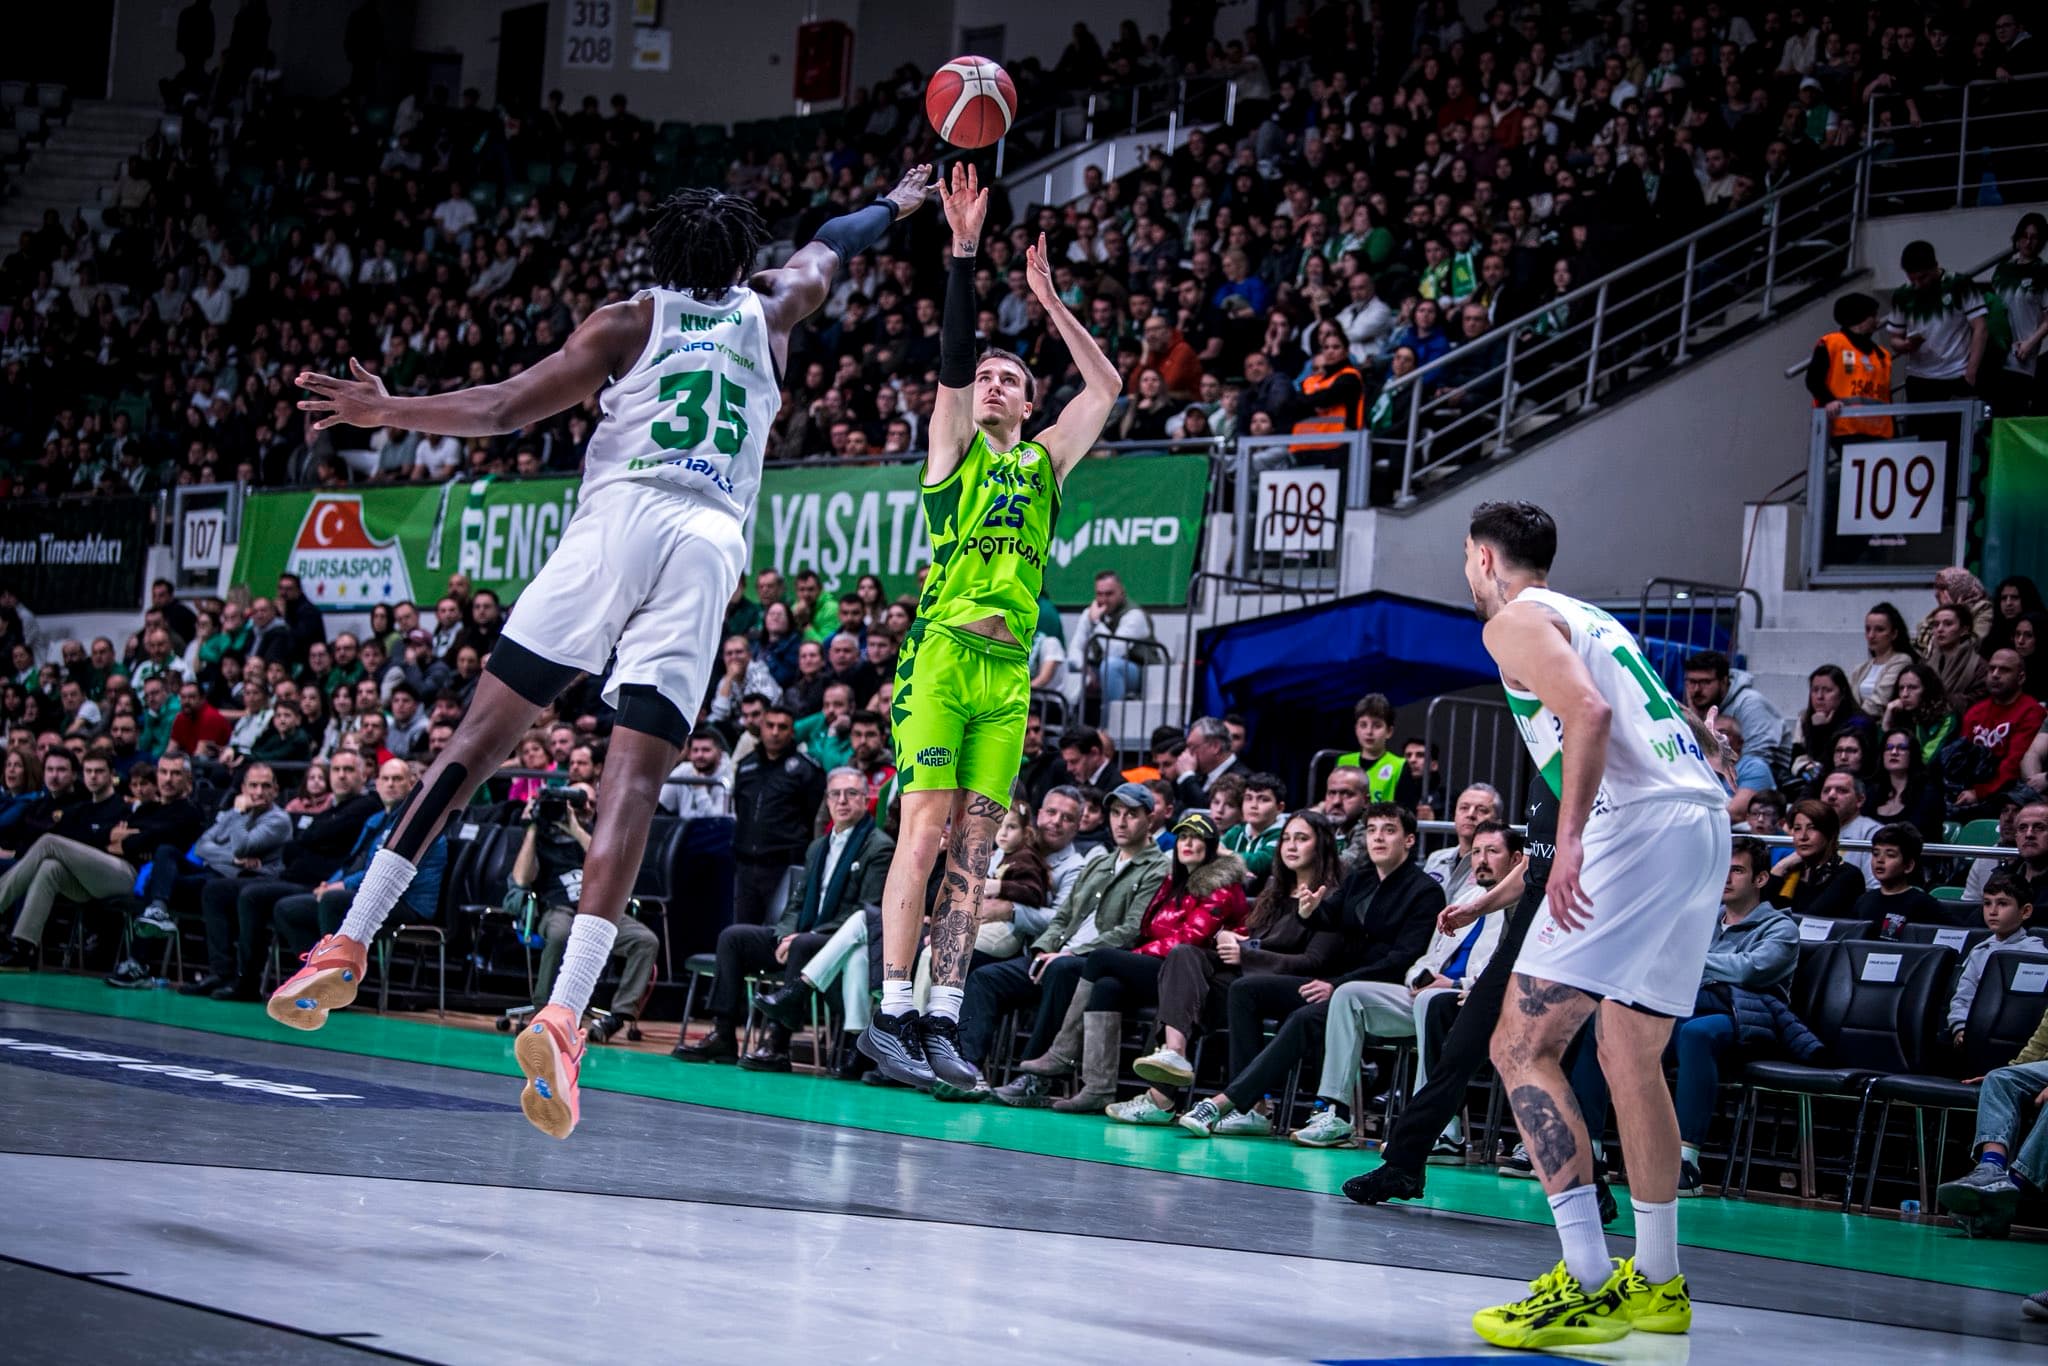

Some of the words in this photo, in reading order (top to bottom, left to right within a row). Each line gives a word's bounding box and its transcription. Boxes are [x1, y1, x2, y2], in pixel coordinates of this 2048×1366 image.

[572, 0, 611, 28] 313
[568, 37, 611, 63] 208
[651, 370, 749, 458] 35
[1852, 455, 1935, 520] 109
[982, 493, 1032, 529] 25
[1268, 482, 1326, 537] 108
[189, 519, 218, 560] 107
[298, 556, 393, 579] BURSASPOR
